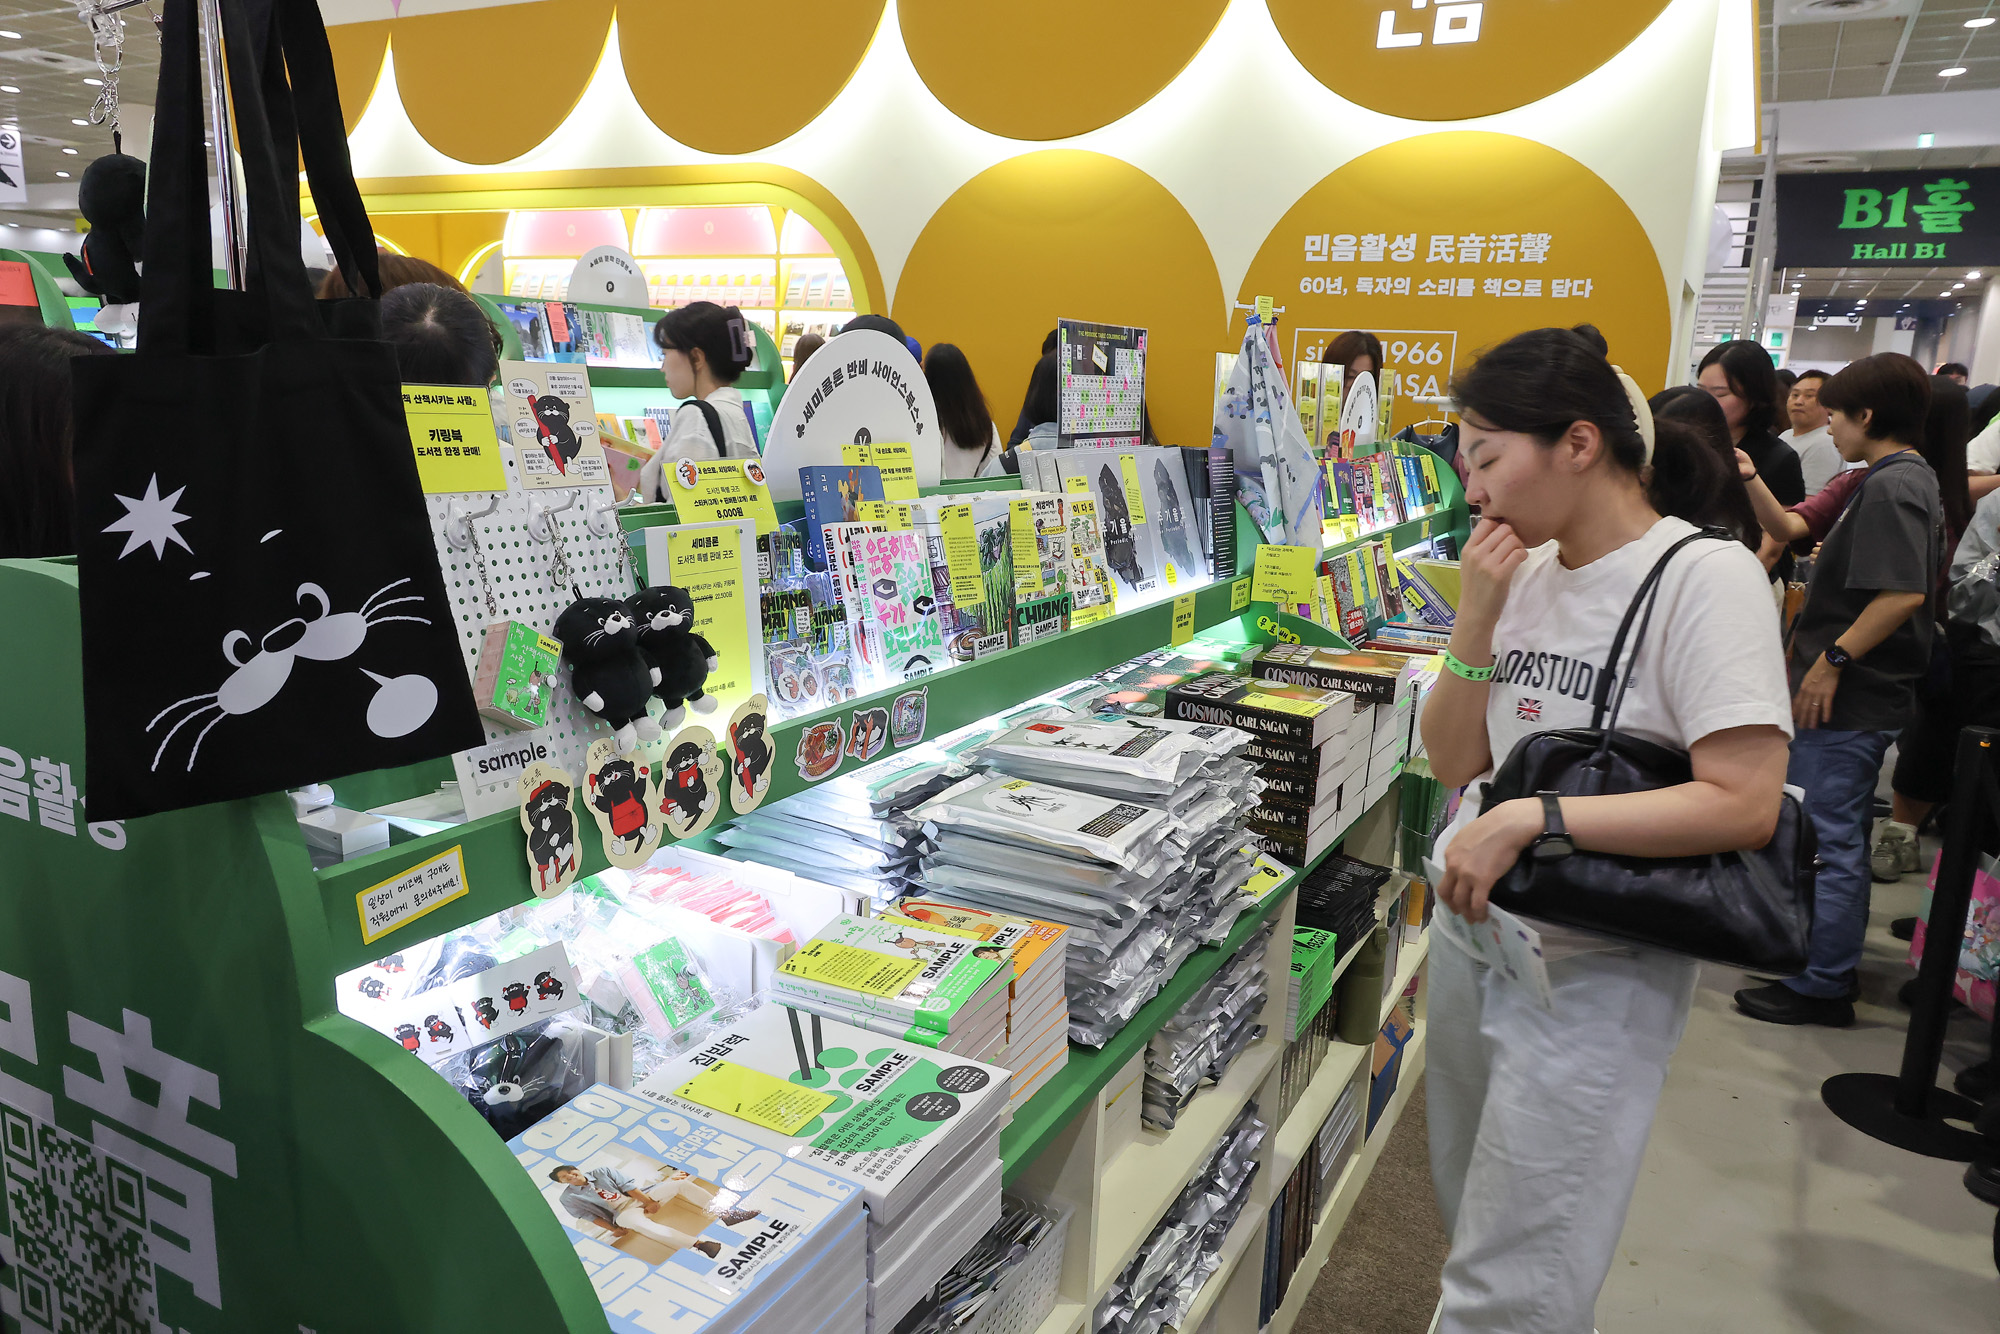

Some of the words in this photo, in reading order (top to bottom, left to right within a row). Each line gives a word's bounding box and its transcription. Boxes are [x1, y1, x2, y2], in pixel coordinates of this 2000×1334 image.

[1838, 178, 1975, 234] B1홀
[1303, 233, 1417, 263] 민음활성
[1425, 232, 1552, 264] 民音活聲
[1851, 243, 1906, 259] Hall
[1912, 243, 1947, 259] B1
[1299, 276, 1348, 296] 60년,
[1355, 277, 1410, 296] 독자의
[1417, 278, 1475, 297] 소리를
[1482, 278, 1542, 298] 책으로
[1550, 278, 1594, 298] 담다
[1381, 341, 1443, 366] 1966
[413, 394, 454, 405] 산책시키는
[802, 367, 845, 423] 세미콜론
[846, 358, 868, 380] 반비
[871, 361, 920, 423] 사이언스북스
[428, 428, 463, 443] 키링북
[417, 446, 442, 457] 도서전
[443, 446, 461, 456] 한정
[462, 446, 481, 456] 판매!
[706, 486, 720, 495] 도서전
[731, 485, 741, 493] 굿즈
[717, 507, 744, 519] 8,000원
[691, 536, 719, 549] 세미콜론
[677, 555, 695, 565] 도서전
[697, 553, 708, 562] 특별
[710, 551, 721, 560] 판매
[723, 549, 734, 559] 굿즈
[715, 591, 733, 600] 22,500원
[1139, 581, 1156, 593] SAMPLE
[875, 599, 907, 627] 누가
[1016, 596, 1070, 627] CHIANG
[1035, 619, 1058, 635] SAMPLE
[1257, 615, 1298, 645] 무료배포
[540, 638, 559, 653] sample
[978, 635, 1004, 652] SAMPLE
[1264, 667, 1318, 689] COSMOS
[1321, 676, 1343, 689] CARL
[1343, 679, 1373, 693] SAGAN
[1177, 701, 1233, 726] COSMOS
[1235, 714, 1259, 730] CARL
[1259, 717, 1290, 735] SAGAN
[478, 741, 547, 774] sample
[1245, 743, 1264, 758] ARL
[1265, 747, 1296, 763] SAGAN
[1253, 807, 1285, 823] SAGAN
[1256, 838, 1283, 854] AGAN
[367, 890, 394, 909] 일상이
[398, 874, 424, 894] 에코백
[426, 862, 451, 878] 구매는
[370, 902, 409, 927] 직원에게
[413, 876, 460, 906] 문의해주세요!
[921, 941, 966, 980] SAMPLE
[689, 1033, 751, 1067] 집밥력
[855, 1052, 909, 1094] SAMPLE
[641, 1089, 656, 1099] 나를
[680, 1101, 703, 1116] 식사의
[703, 1111, 713, 1119] 힘
[619, 1108, 691, 1153] 79
[808, 1131, 841, 1160] “집밥력은
[838, 1118, 855, 1136] 어떤
[853, 1099, 884, 1123] 상황에서도
[821, 1147, 840, 1164] 나를
[837, 1130, 859, 1151] 건강의
[857, 1117, 877, 1136] 궤도로
[663, 1125, 719, 1165] RECIPES
[834, 1147, 855, 1168] 강력한
[853, 1125, 883, 1151] 자신감이
[885, 1144, 900, 1160] 집밥
[903, 1138, 923, 1157] 최신작
[852, 1146, 883, 1174] 베스트셀러
[717, 1218, 790, 1280] SAMPLE
